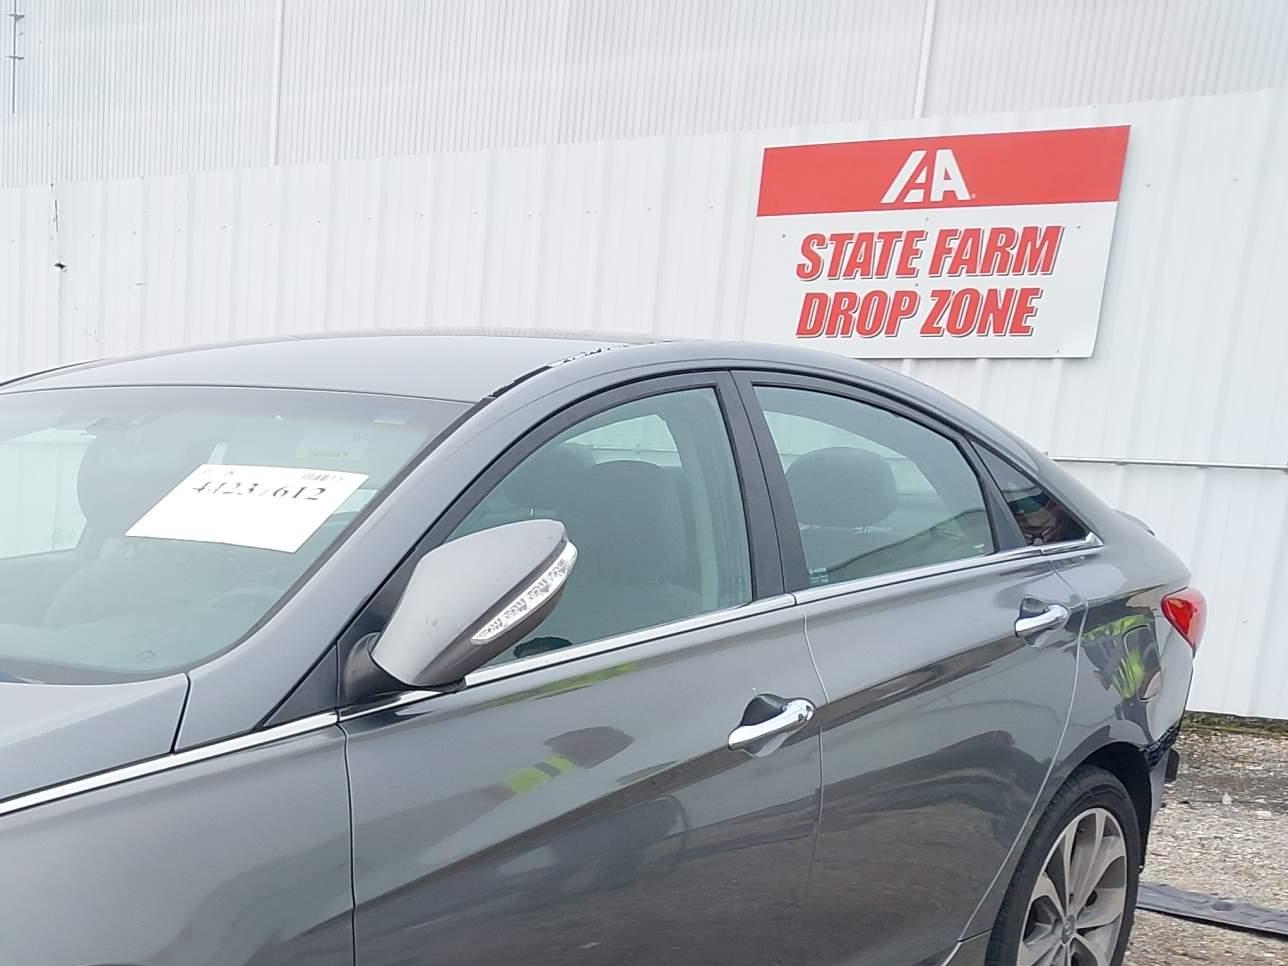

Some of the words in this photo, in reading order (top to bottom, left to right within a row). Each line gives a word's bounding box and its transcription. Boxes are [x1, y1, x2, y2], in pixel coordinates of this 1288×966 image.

[796, 229, 927, 280] STATE
[929, 226, 1064, 275] FARM
[796, 290, 920, 337] DROP
[920, 287, 1043, 336] ZONE
